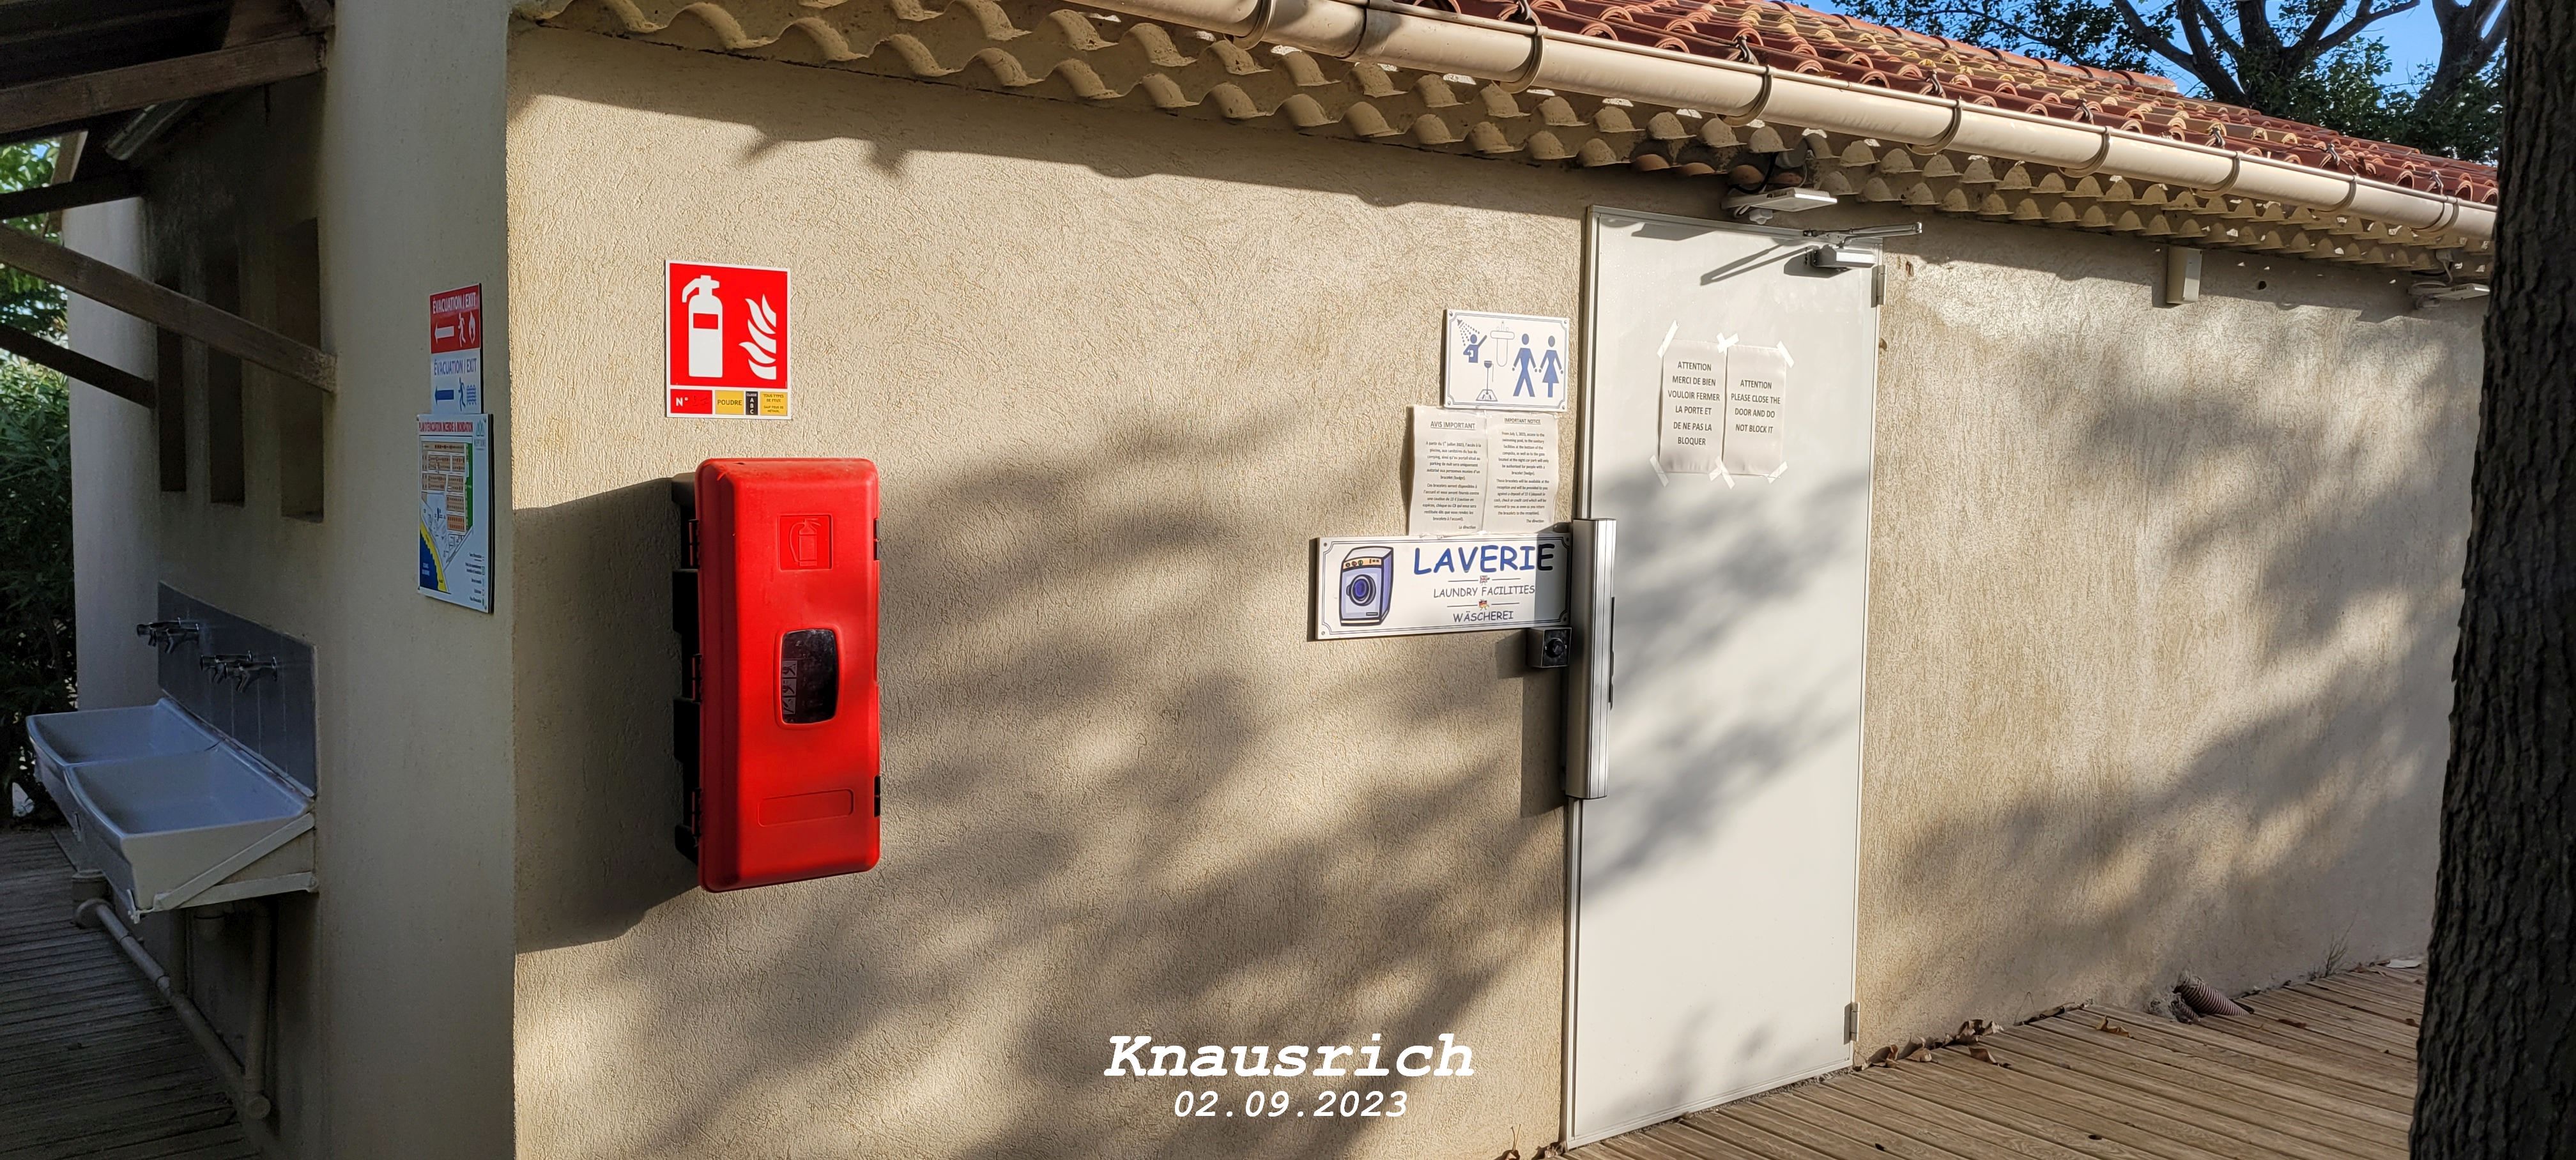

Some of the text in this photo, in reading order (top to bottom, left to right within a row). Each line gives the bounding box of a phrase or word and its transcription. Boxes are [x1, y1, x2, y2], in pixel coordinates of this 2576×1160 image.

[433, 294, 461, 314] ÉVACUATION
[466, 292, 476, 308] EXIT
[434, 360, 463, 376] ÉVACUATION
[467, 358, 477, 373] EXIT
[1678, 362, 1712, 371] ATTENTION
[1740, 379, 1772, 389] ATTENTION
[1668, 391, 1720, 401] VOULOIR FERMER
[1731, 393, 1751, 402] PLEASE
[675, 397, 688, 406] N°
[1735, 408, 1752, 416] DOOR
[1753, 409, 1765, 417] AND
[1678, 437, 1706, 446] BLOQUER
[1414, 544, 1556, 575] LAVERIE
[1434, 584, 1535, 598] LAUNDRY FACILITIES
[1453, 610, 1514, 622] WÄSCHEREI
